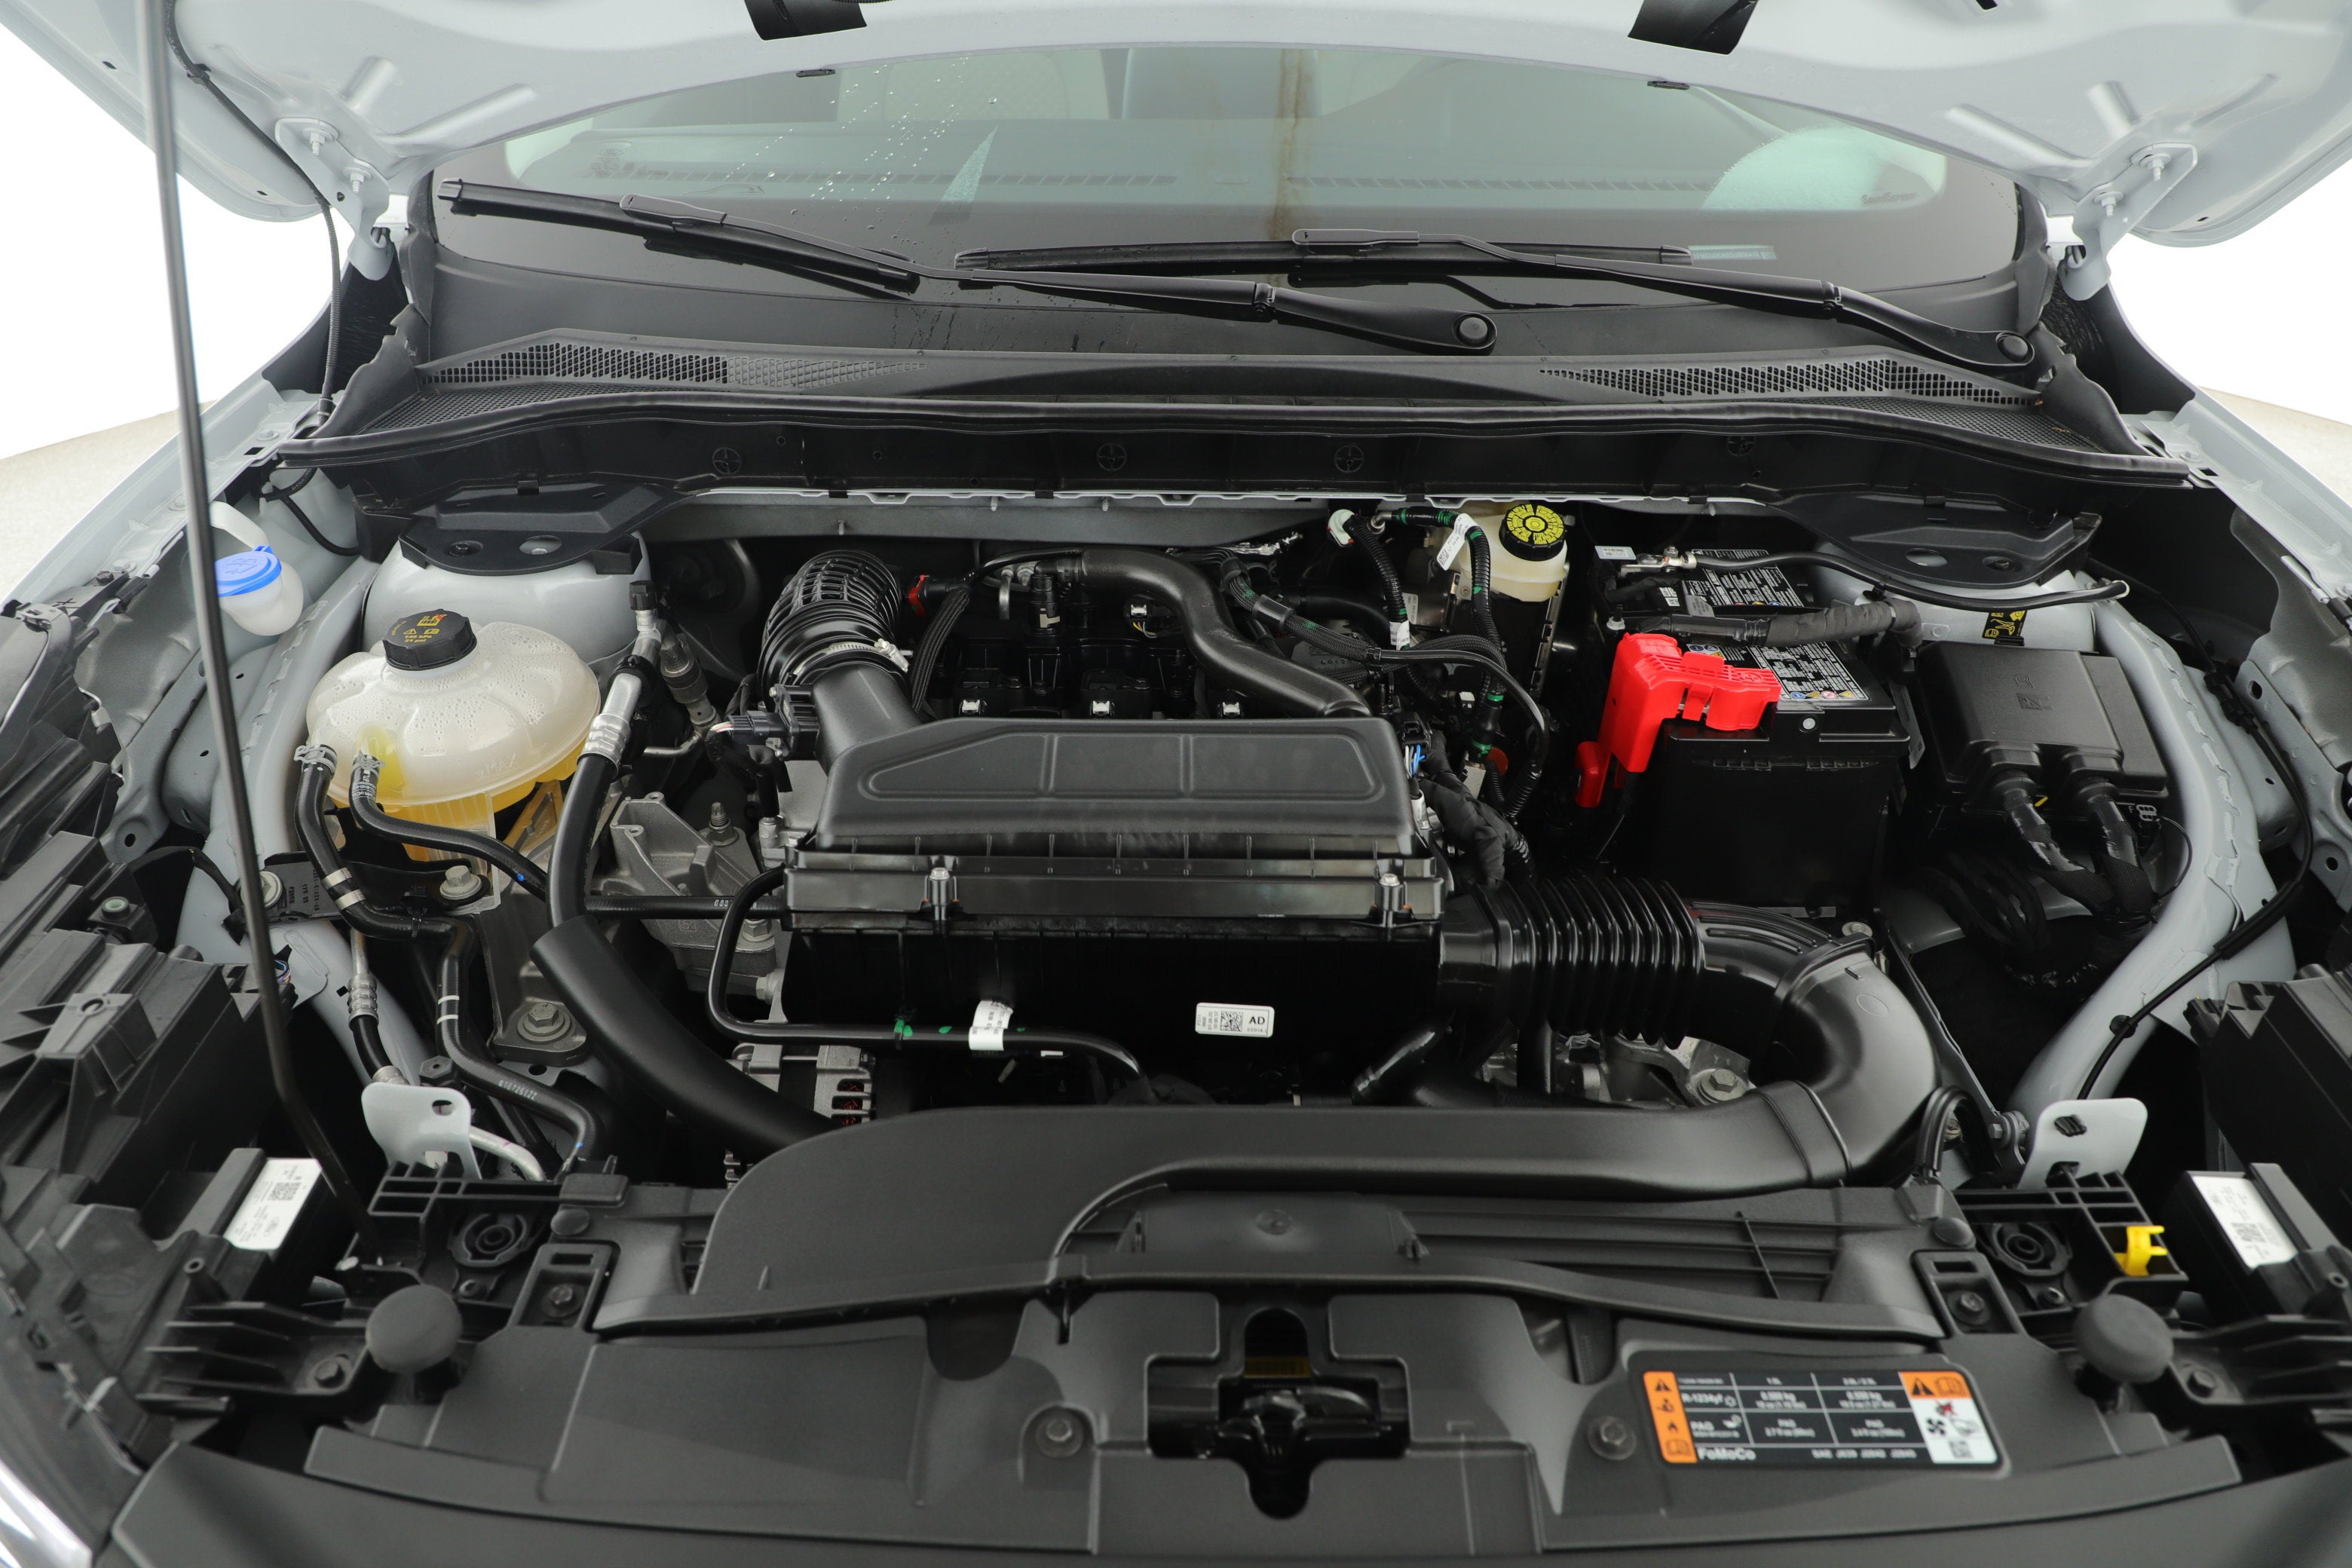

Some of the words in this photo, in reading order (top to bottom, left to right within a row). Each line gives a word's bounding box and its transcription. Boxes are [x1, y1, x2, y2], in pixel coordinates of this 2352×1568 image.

[1248, 1015, 1266, 1025] AD
[1680, 1392, 1723, 1405] R-1234yf
[1689, 1420, 1715, 1431] PAG
[1695, 1447, 1756, 1461] FoMoCo
